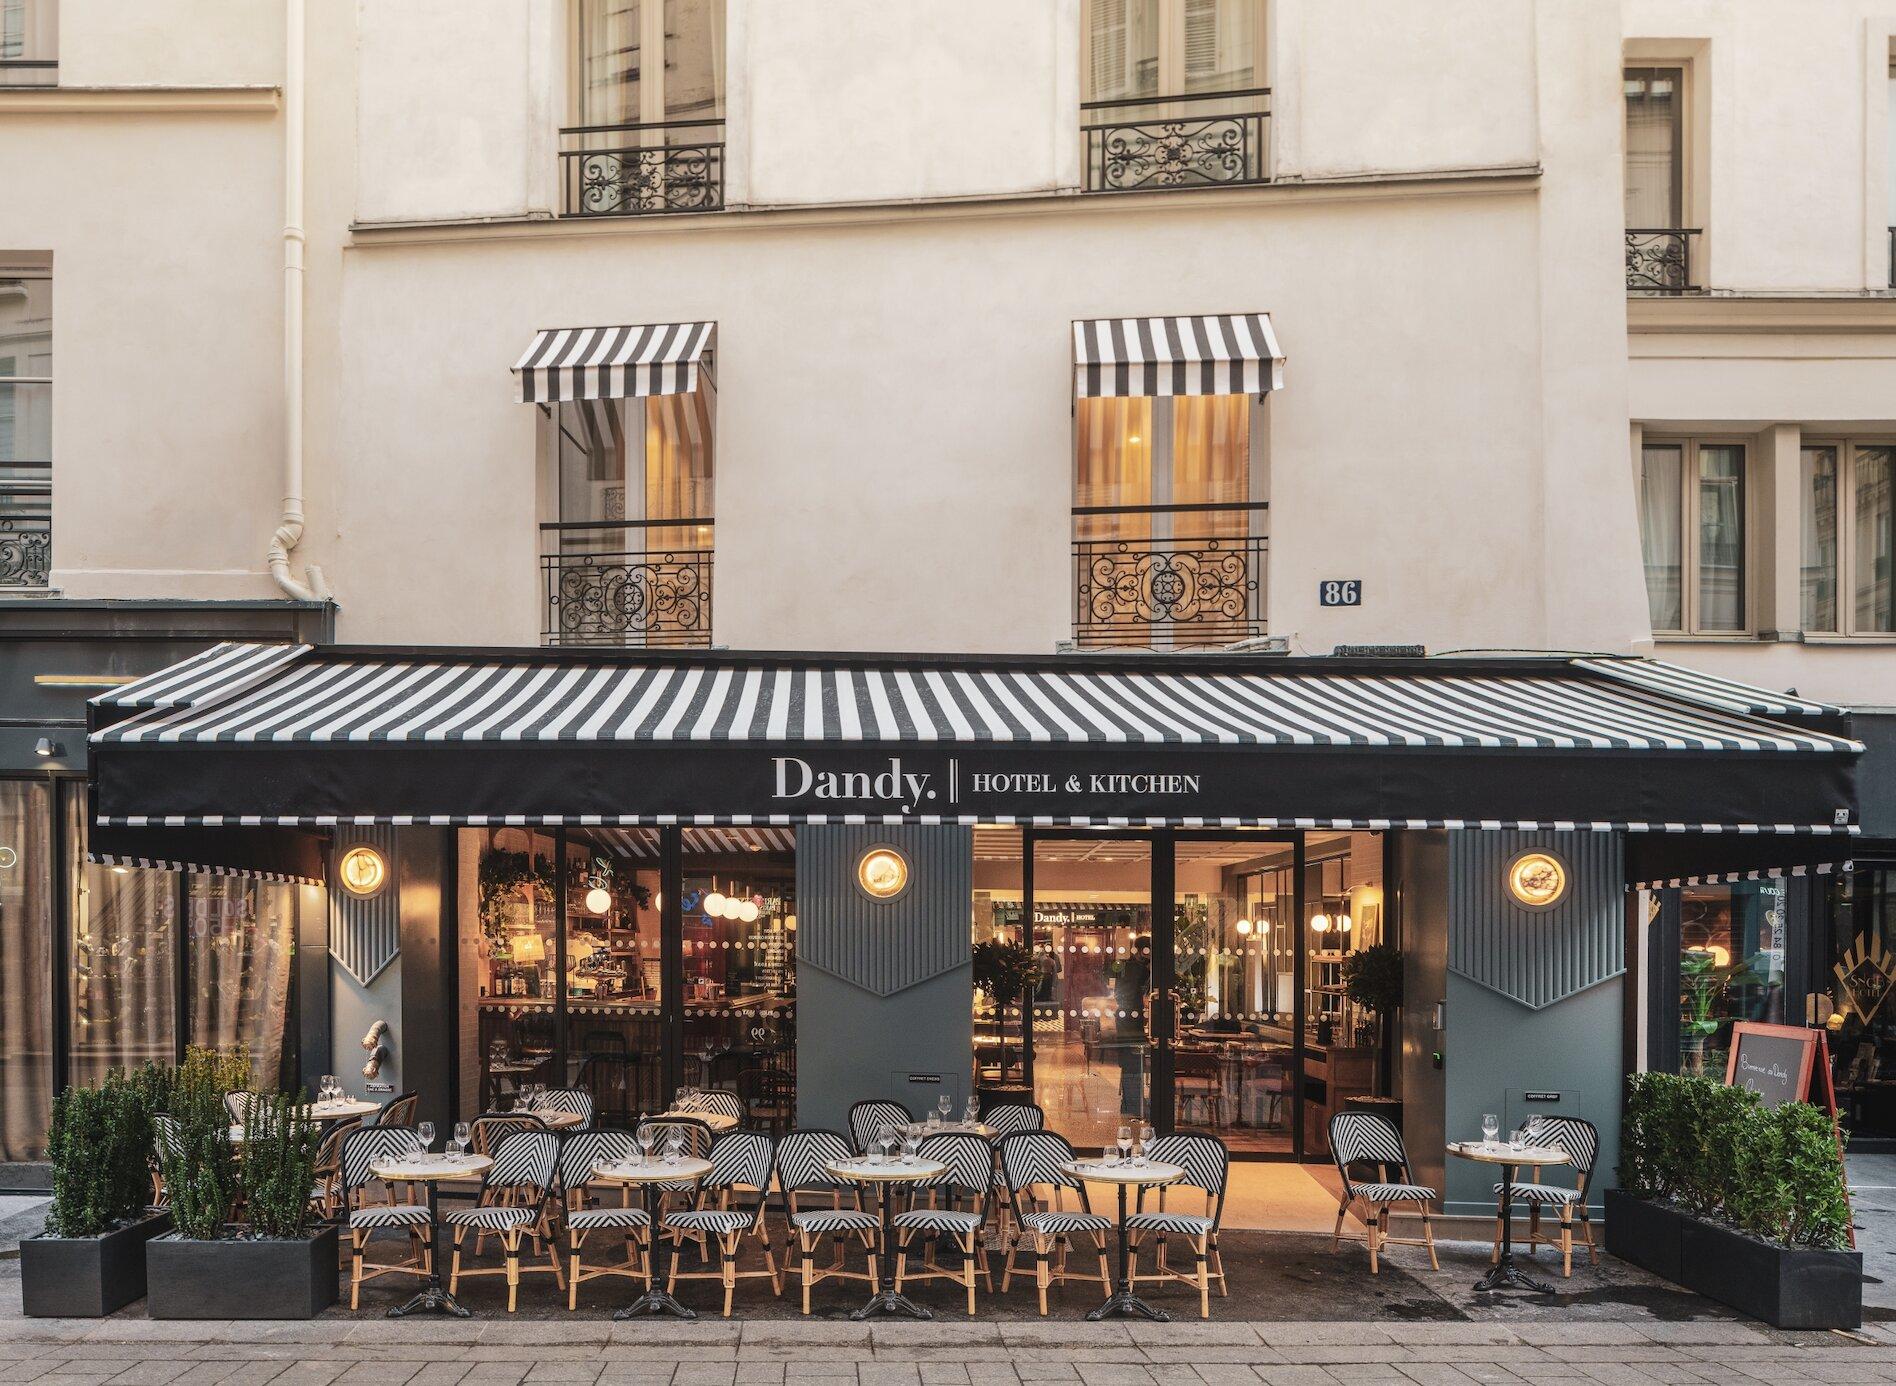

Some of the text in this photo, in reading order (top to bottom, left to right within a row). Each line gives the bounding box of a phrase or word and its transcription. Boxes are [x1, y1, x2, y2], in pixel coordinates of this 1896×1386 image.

[1325, 581, 1357, 605] 86
[771, 757, 1201, 814] Dandy. HOTEL & KITCHEN
[1033, 911, 1070, 926] Dandy.
